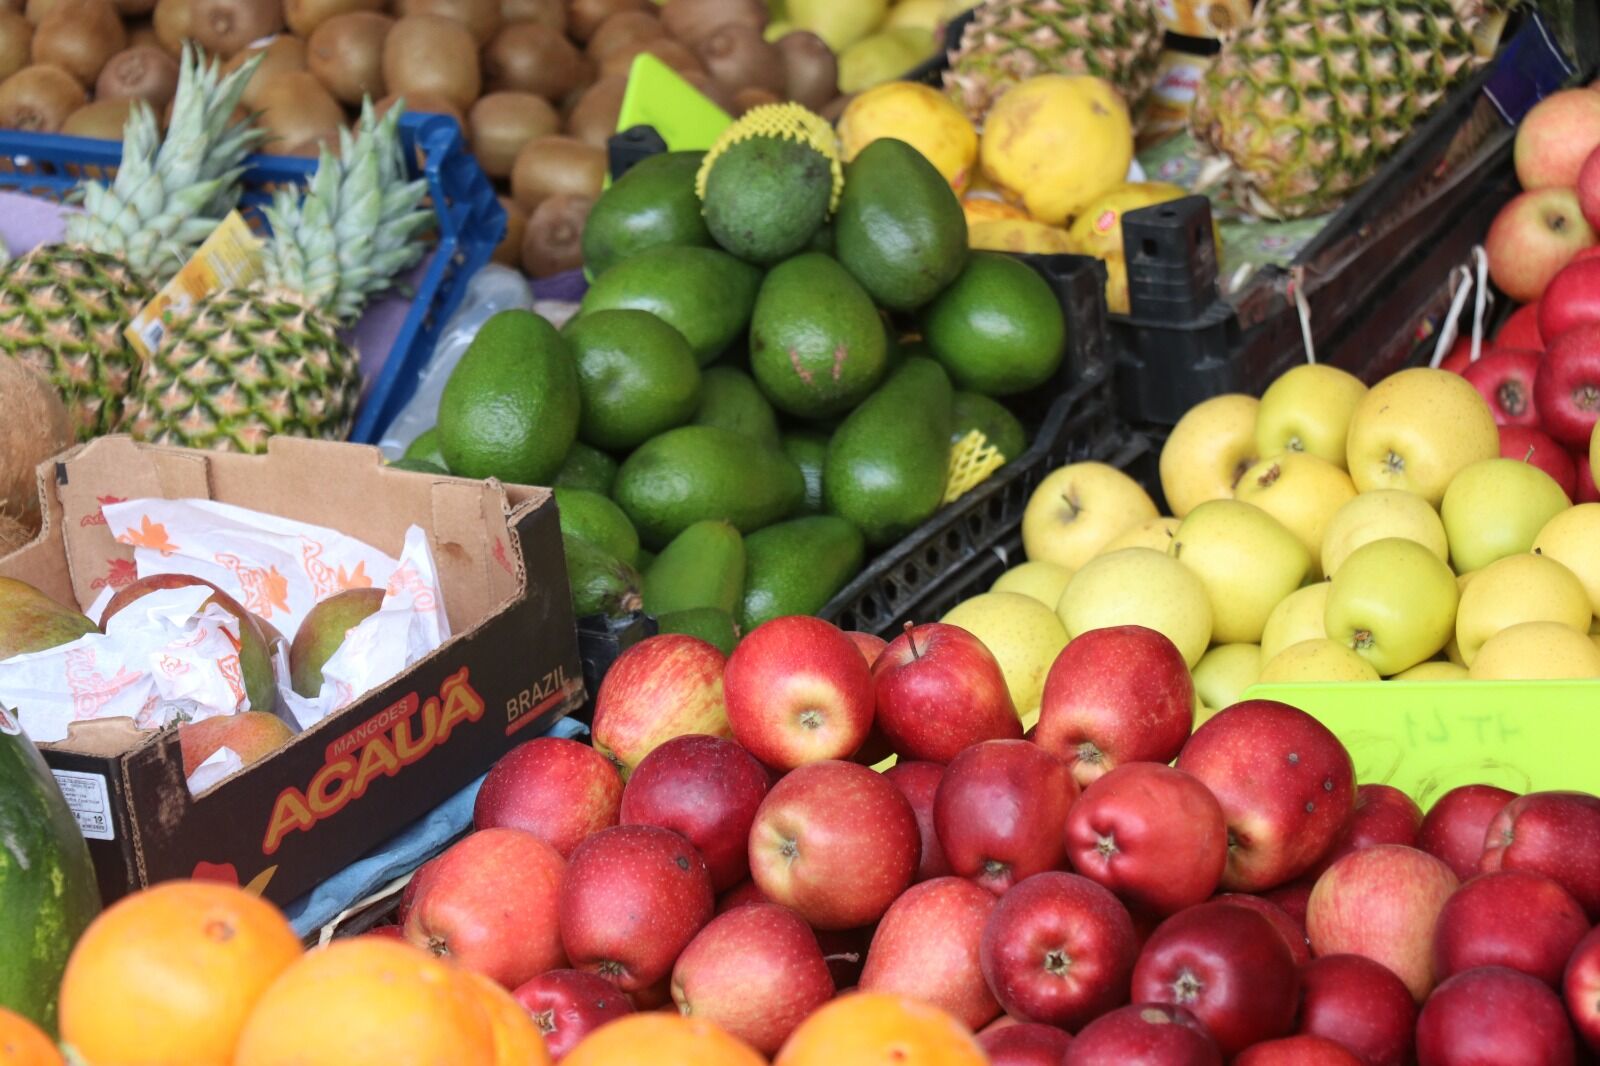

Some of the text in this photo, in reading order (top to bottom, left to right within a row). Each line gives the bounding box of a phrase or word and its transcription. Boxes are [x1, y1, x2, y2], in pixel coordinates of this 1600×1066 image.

[506, 665, 567, 722] BRAZIL
[333, 699, 409, 755] MANGOES
[262, 665, 485, 855] ACAUÃ
